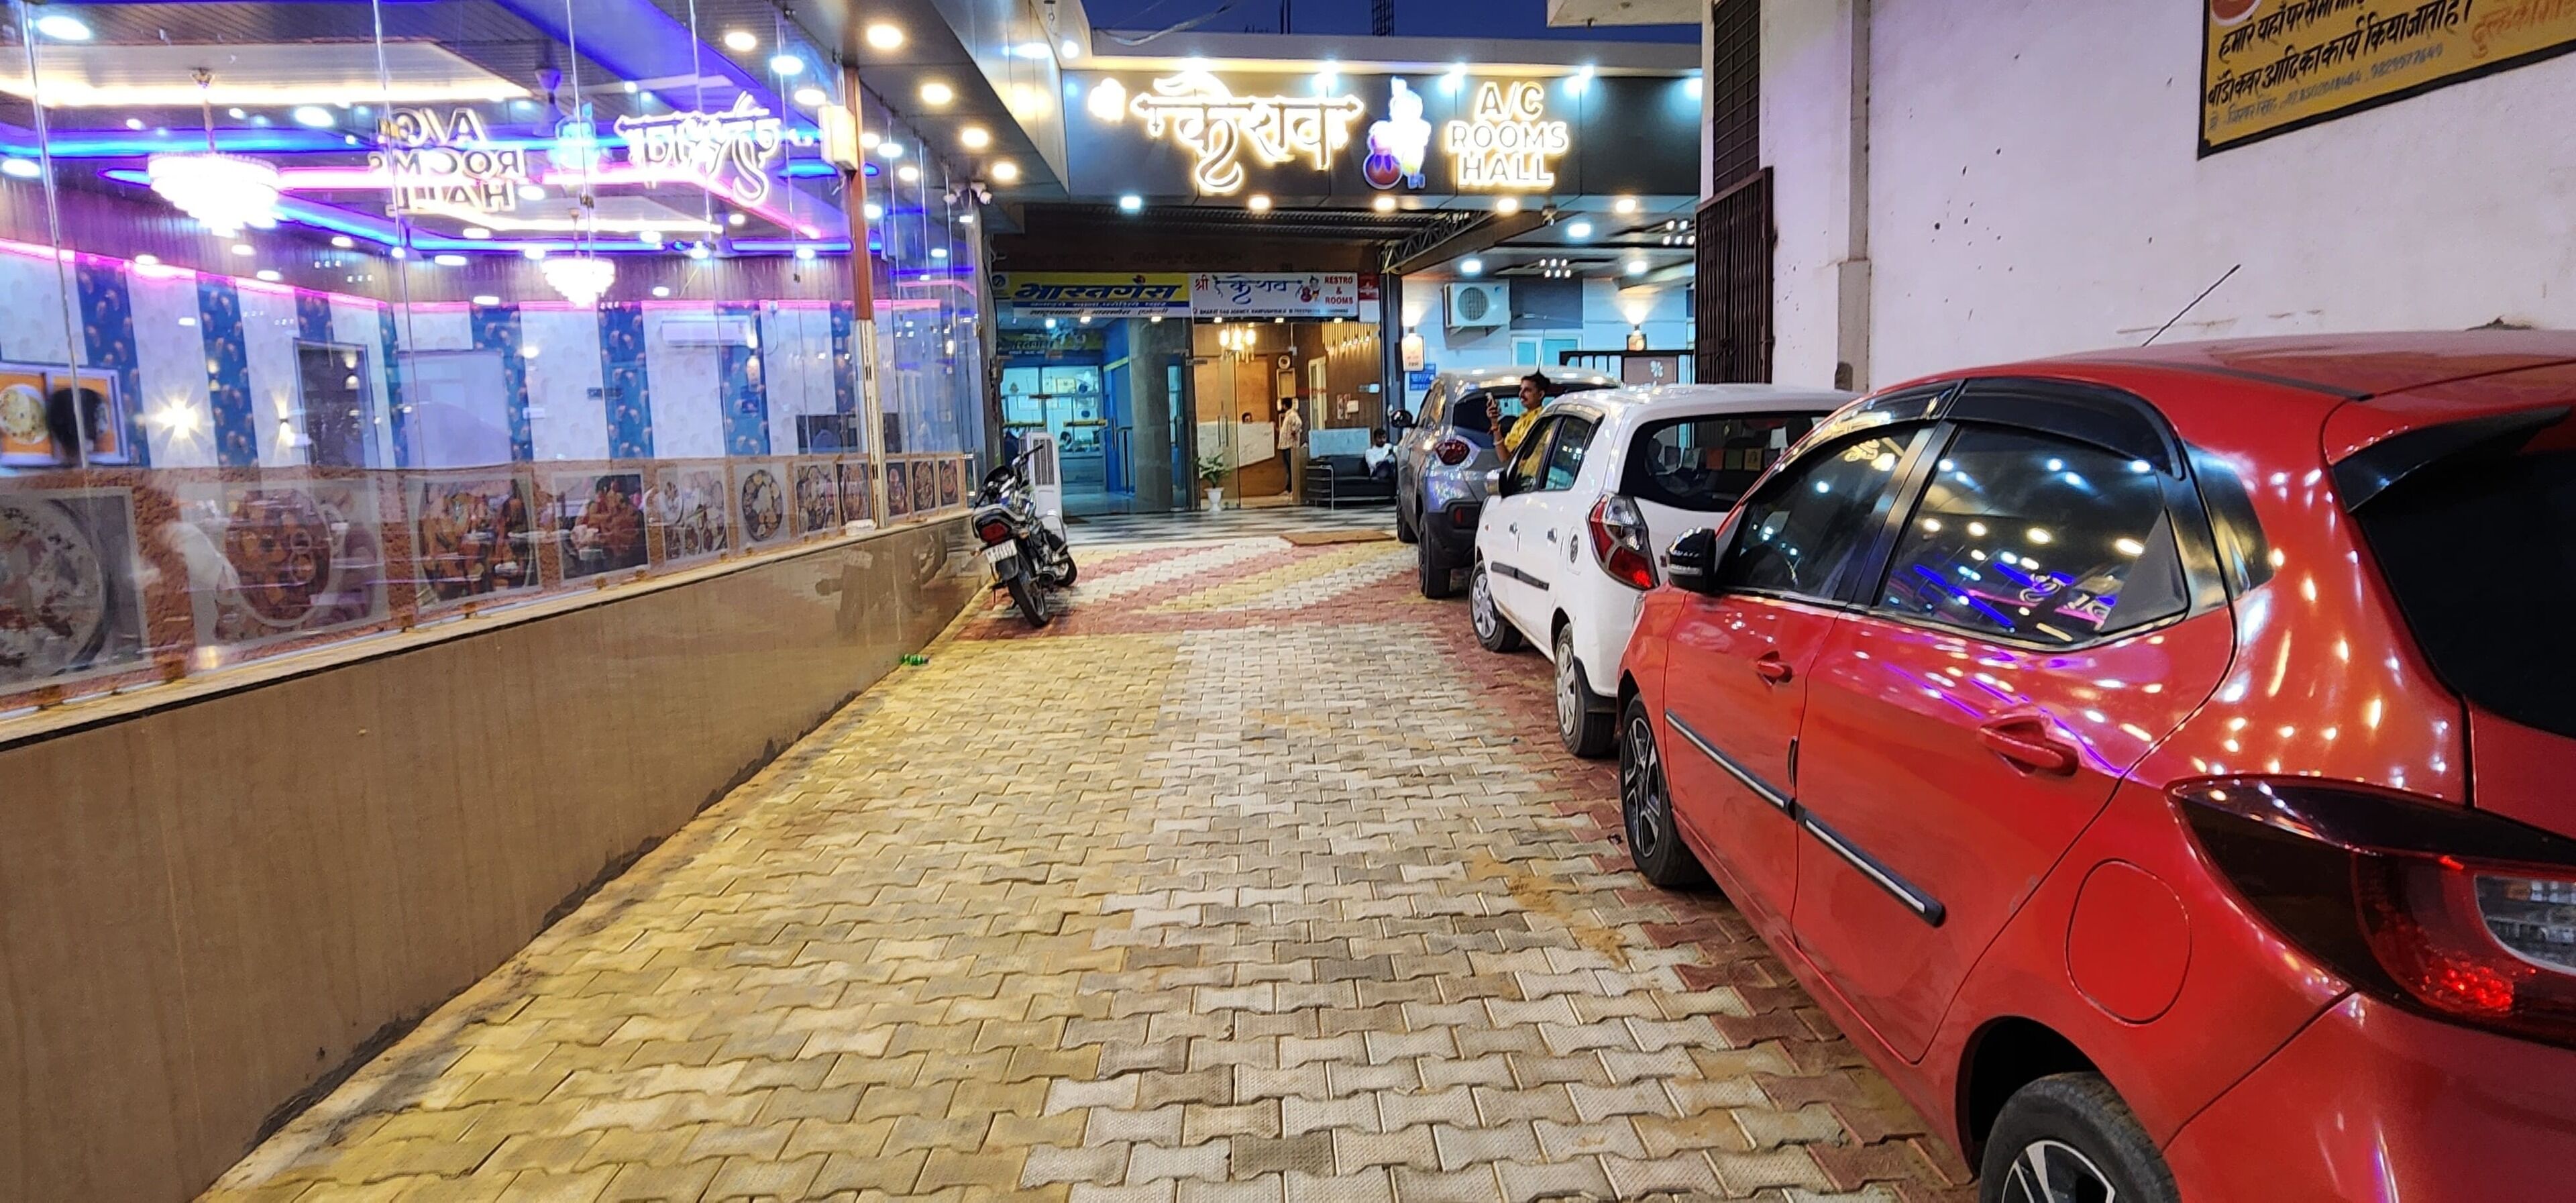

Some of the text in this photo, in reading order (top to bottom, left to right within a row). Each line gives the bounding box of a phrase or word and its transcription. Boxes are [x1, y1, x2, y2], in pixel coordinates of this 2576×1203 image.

[1478, 83, 1542, 118] A/C
[1450, 123, 1567, 151] ROOMS
[1460, 154, 1553, 182] HALL
[1324, 276, 1353, 284] RESTRO
[1336, 286, 1342, 295] &
